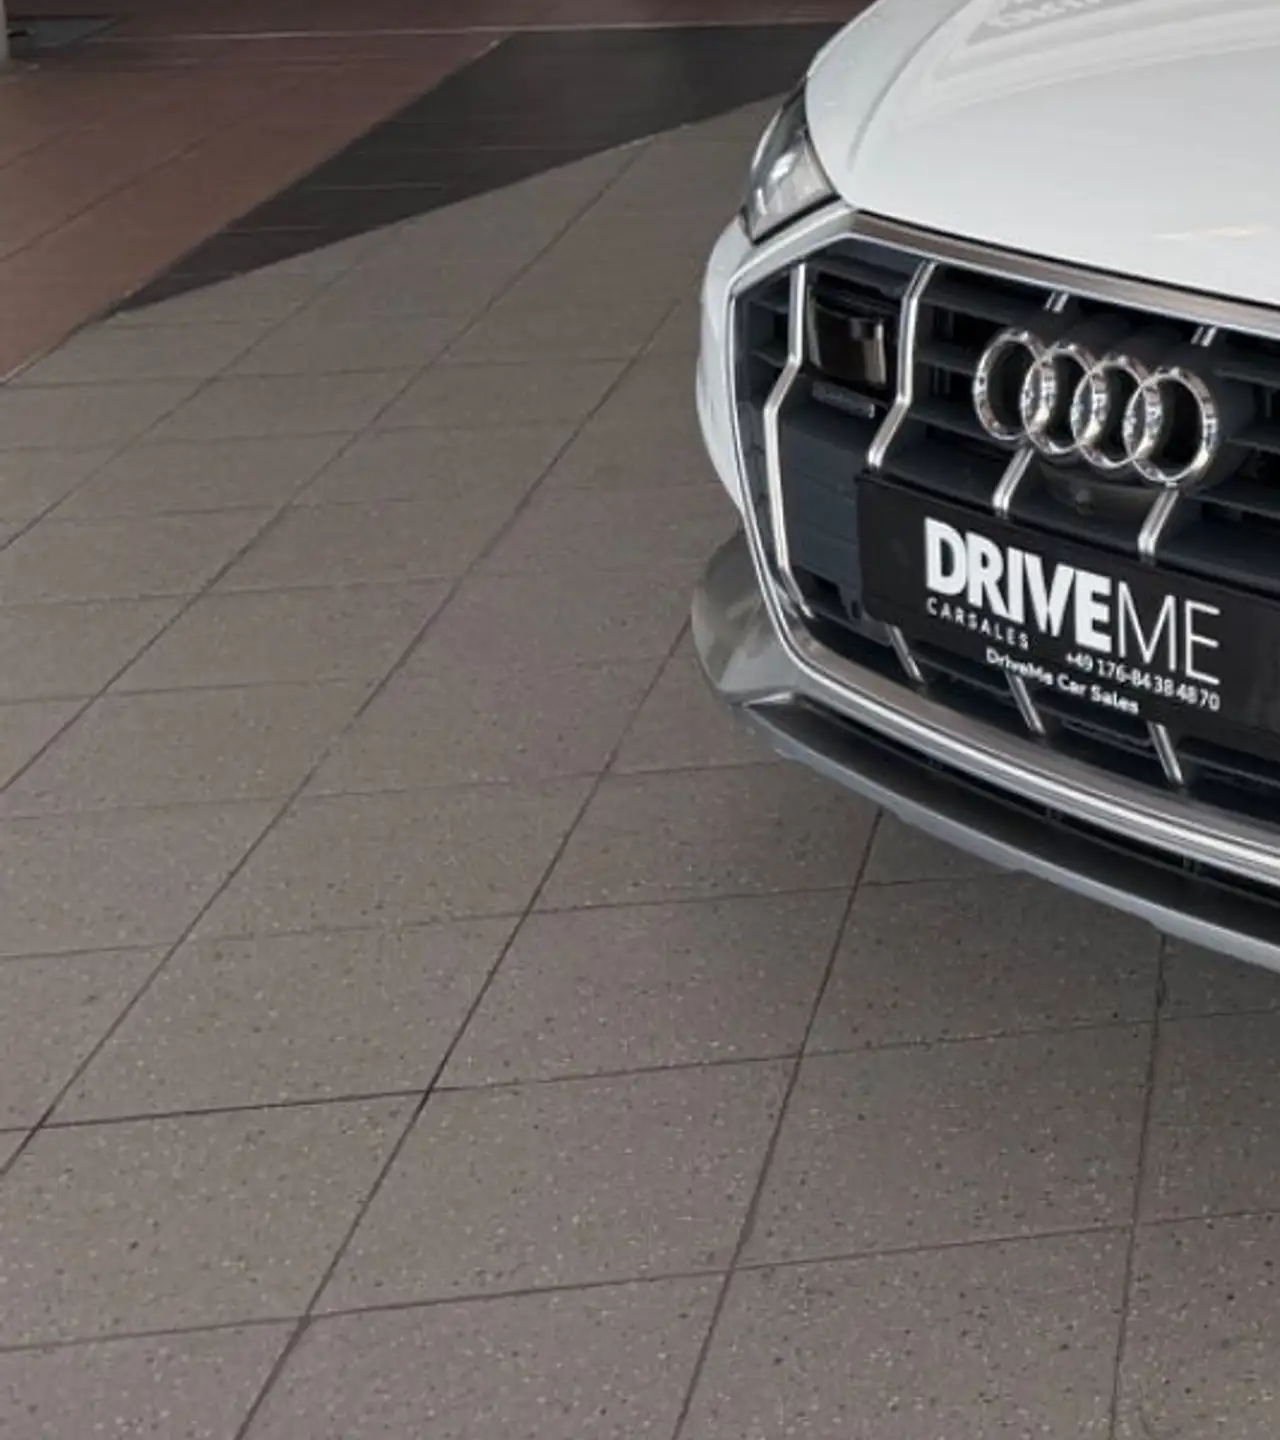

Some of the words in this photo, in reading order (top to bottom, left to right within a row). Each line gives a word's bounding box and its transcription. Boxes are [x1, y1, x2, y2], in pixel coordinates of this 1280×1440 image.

[923, 516, 1221, 686] DRIVEME
[926, 596, 1030, 651] CARSALES
[1056, 672, 1088, 698] Car
[1090, 683, 1140, 716] Sales
[1065, 652, 1094, 672] +49
[1200, 688, 1221, 711] 70
